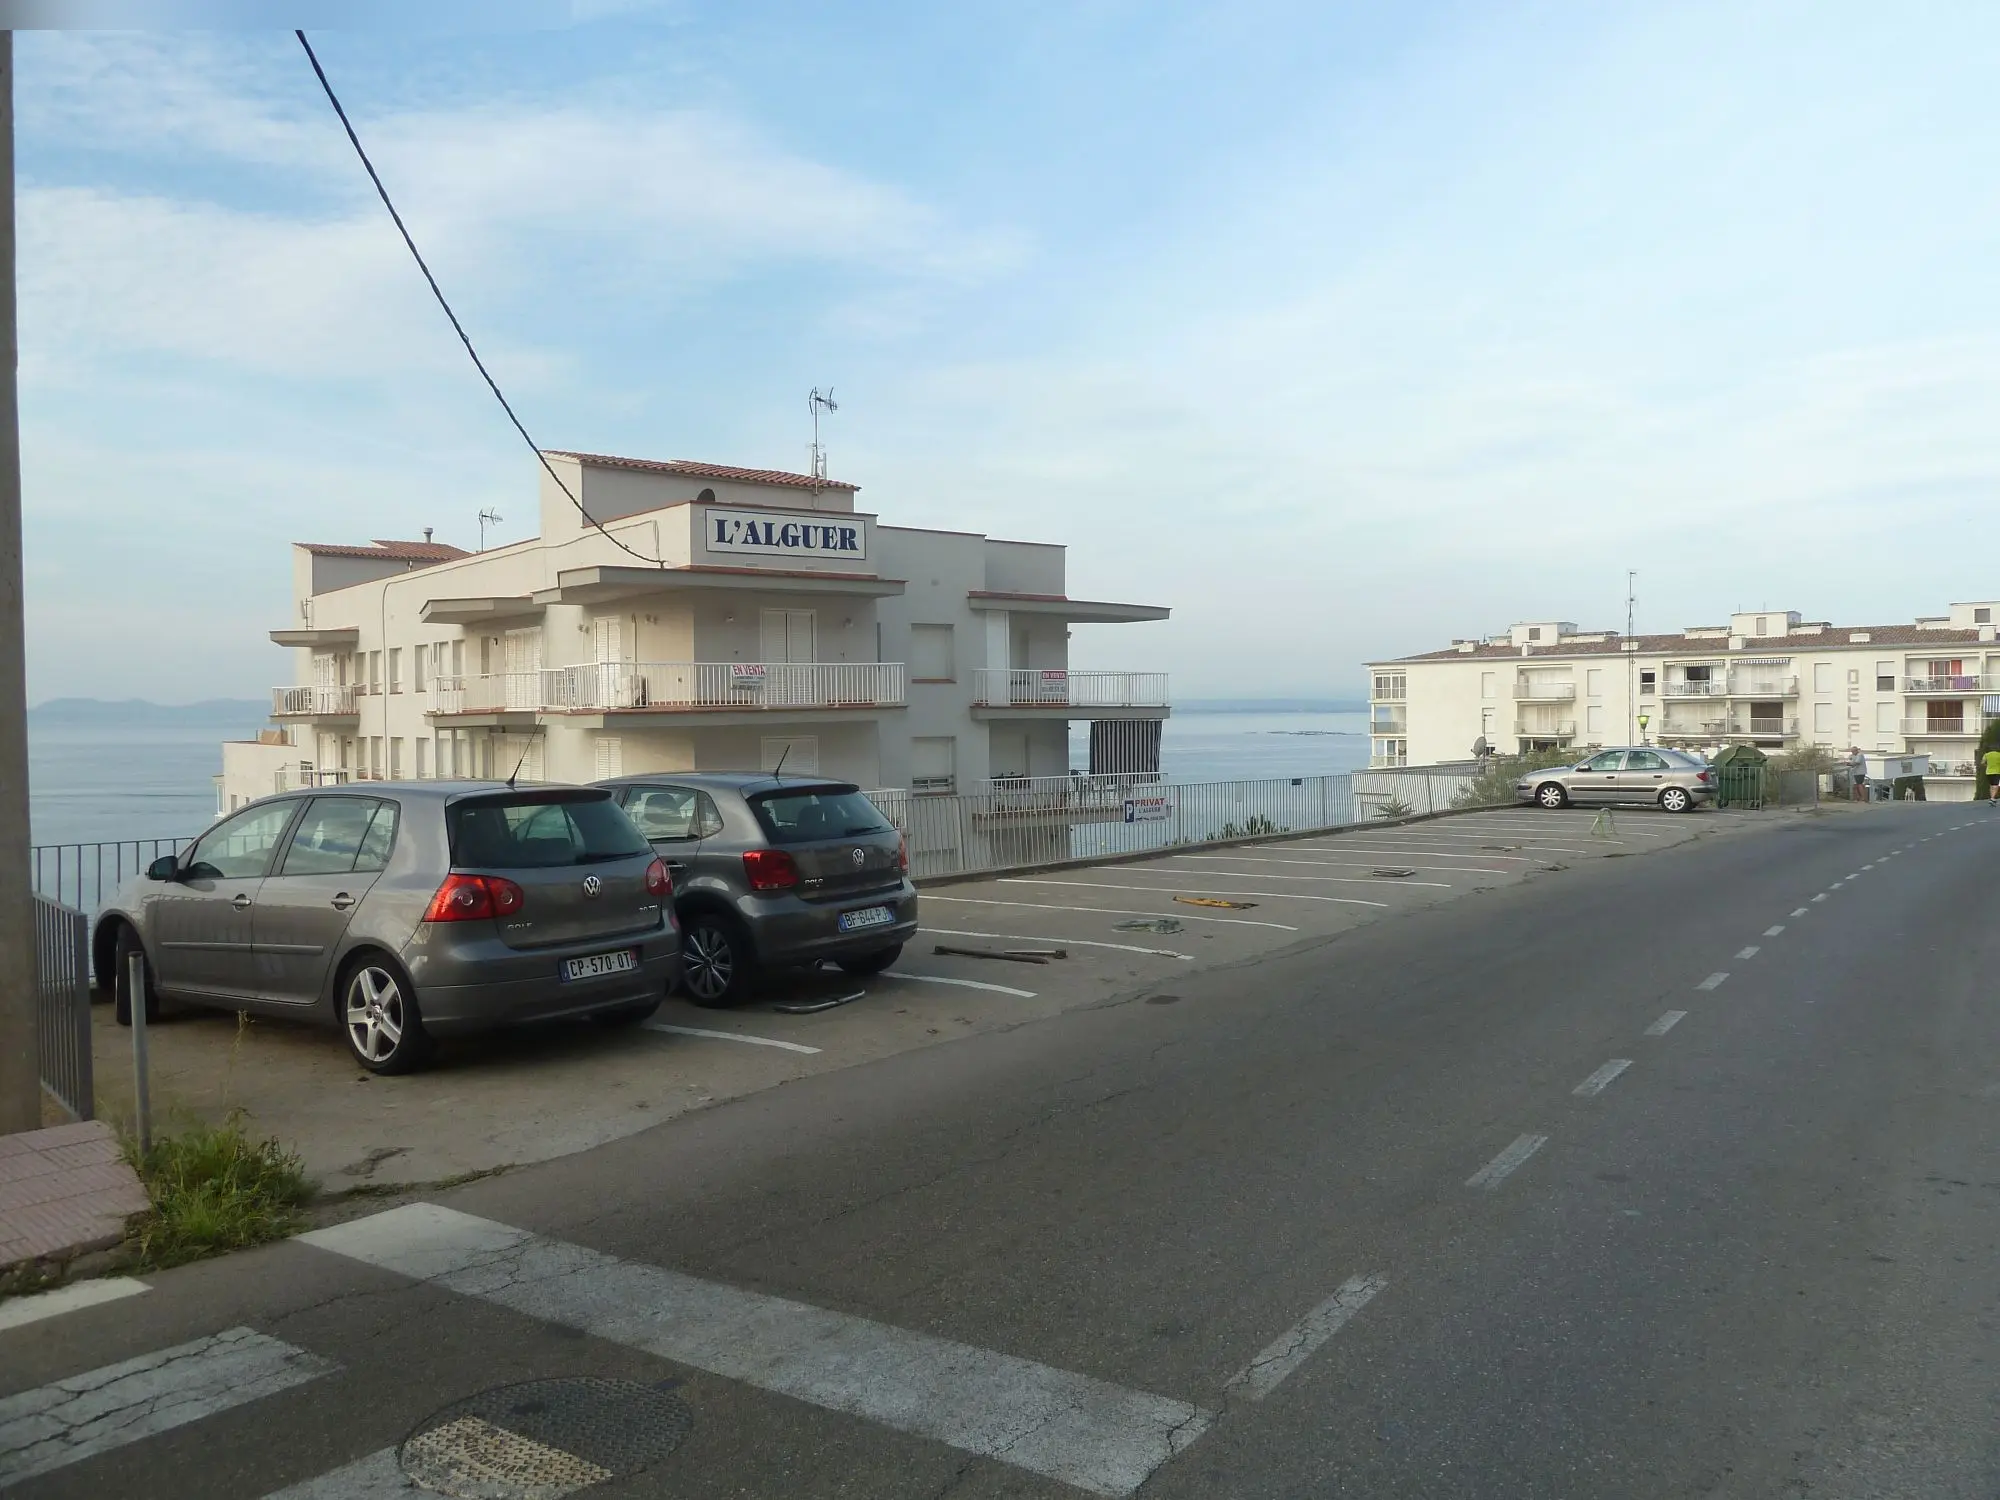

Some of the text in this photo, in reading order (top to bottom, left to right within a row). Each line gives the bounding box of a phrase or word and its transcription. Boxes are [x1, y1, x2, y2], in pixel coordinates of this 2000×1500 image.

[714, 518, 860, 551] L'ALGUER
[732, 664, 766, 676] EN VENTA
[1134, 797, 1165, 807] PRIVAT
[1126, 803, 1134, 820] P
